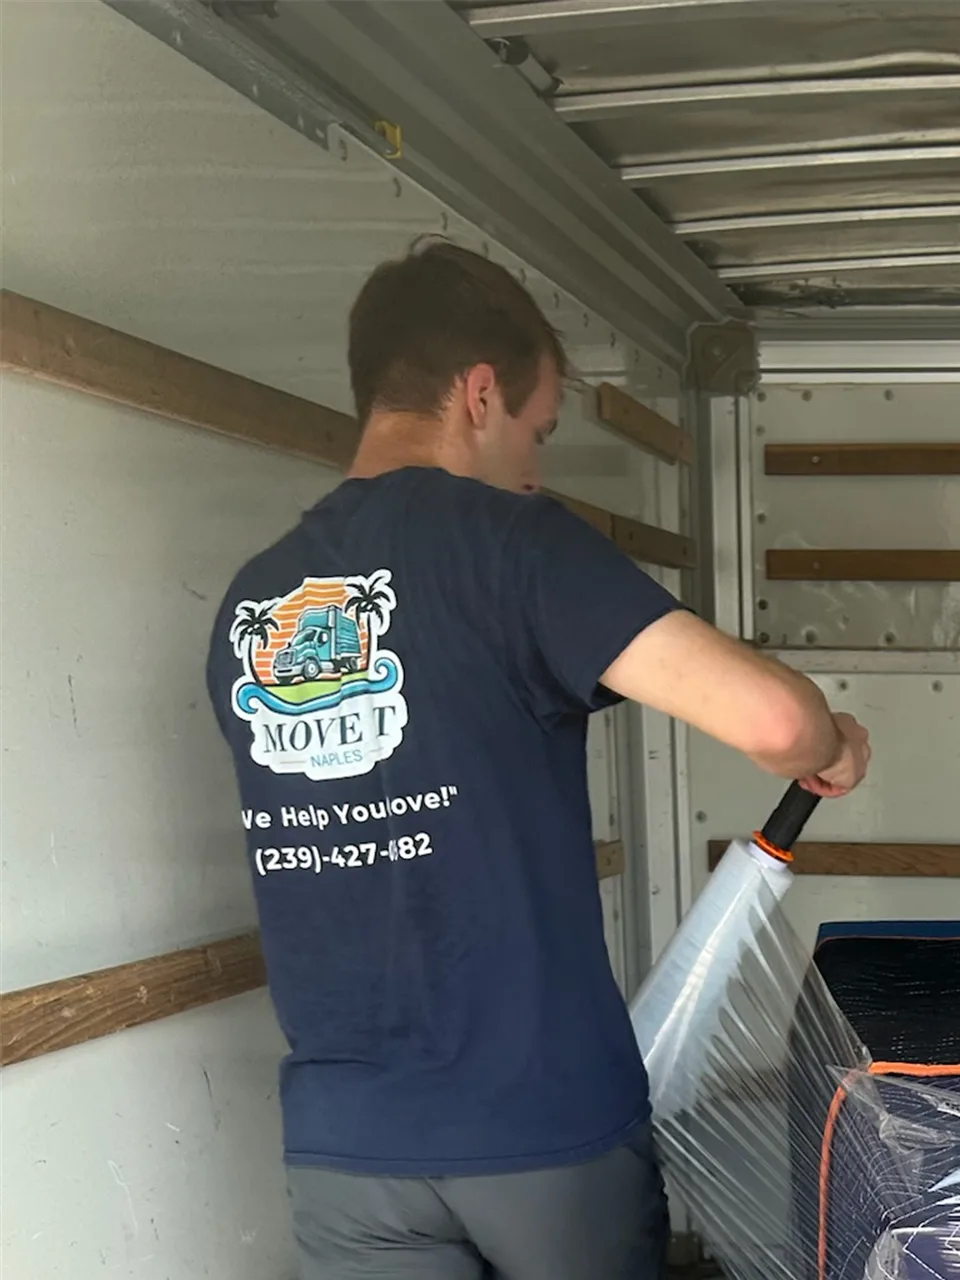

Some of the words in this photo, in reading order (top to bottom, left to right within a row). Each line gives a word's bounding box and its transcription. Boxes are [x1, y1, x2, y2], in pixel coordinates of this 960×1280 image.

[262, 712, 363, 753] MOVE
[311, 749, 363, 767] NAPLES
[281, 804, 329, 831] Help
[332, 801, 387, 825] You
[386, 786, 458, 816] ove!"
